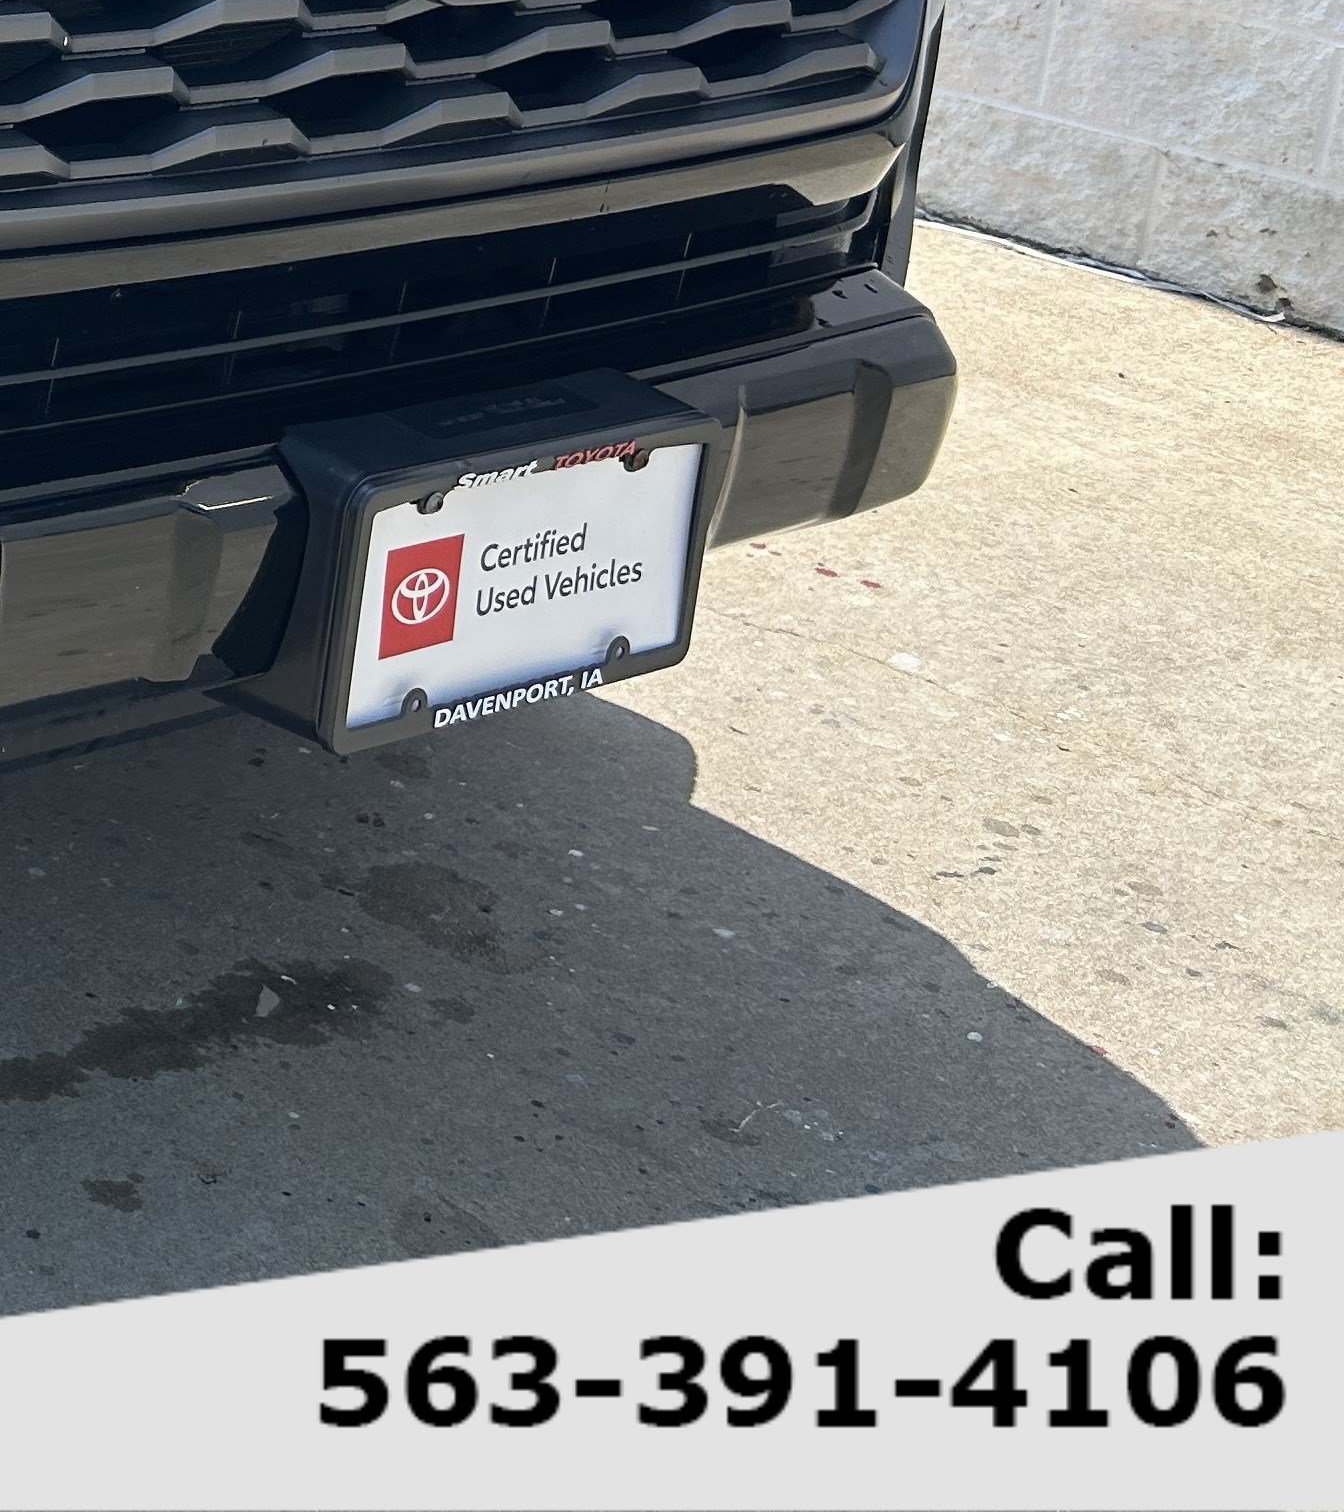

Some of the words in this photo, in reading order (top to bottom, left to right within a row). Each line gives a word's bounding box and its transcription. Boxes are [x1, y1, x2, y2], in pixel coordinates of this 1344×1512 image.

[457, 459, 538, 490] Smart
[553, 439, 637, 470] TOYOTA
[480, 523, 588, 573] Certified
[475, 578, 537, 617] Used
[543, 558, 643, 601] Vehicles
[433, 673, 575, 729] DAVENPORT,
[580, 667, 605, 690] IA
